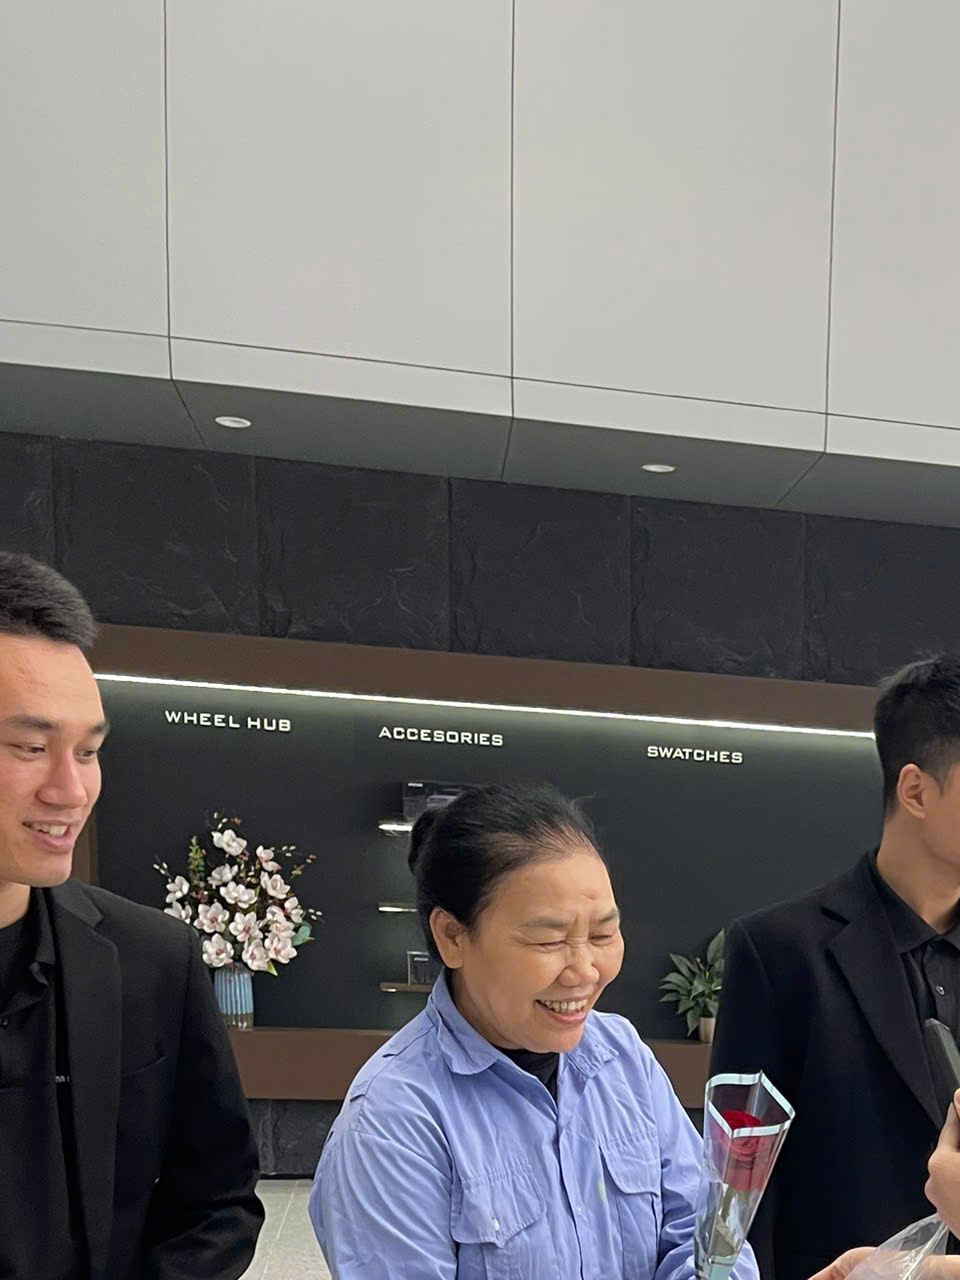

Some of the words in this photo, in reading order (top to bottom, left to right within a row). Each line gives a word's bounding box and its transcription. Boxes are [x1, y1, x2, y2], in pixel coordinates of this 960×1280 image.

[165, 710, 240, 728] WHEEL
[247, 717, 291, 732] HUB
[379, 726, 503, 746] ACCESORIES
[647, 745, 743, 763] SWATCHES
